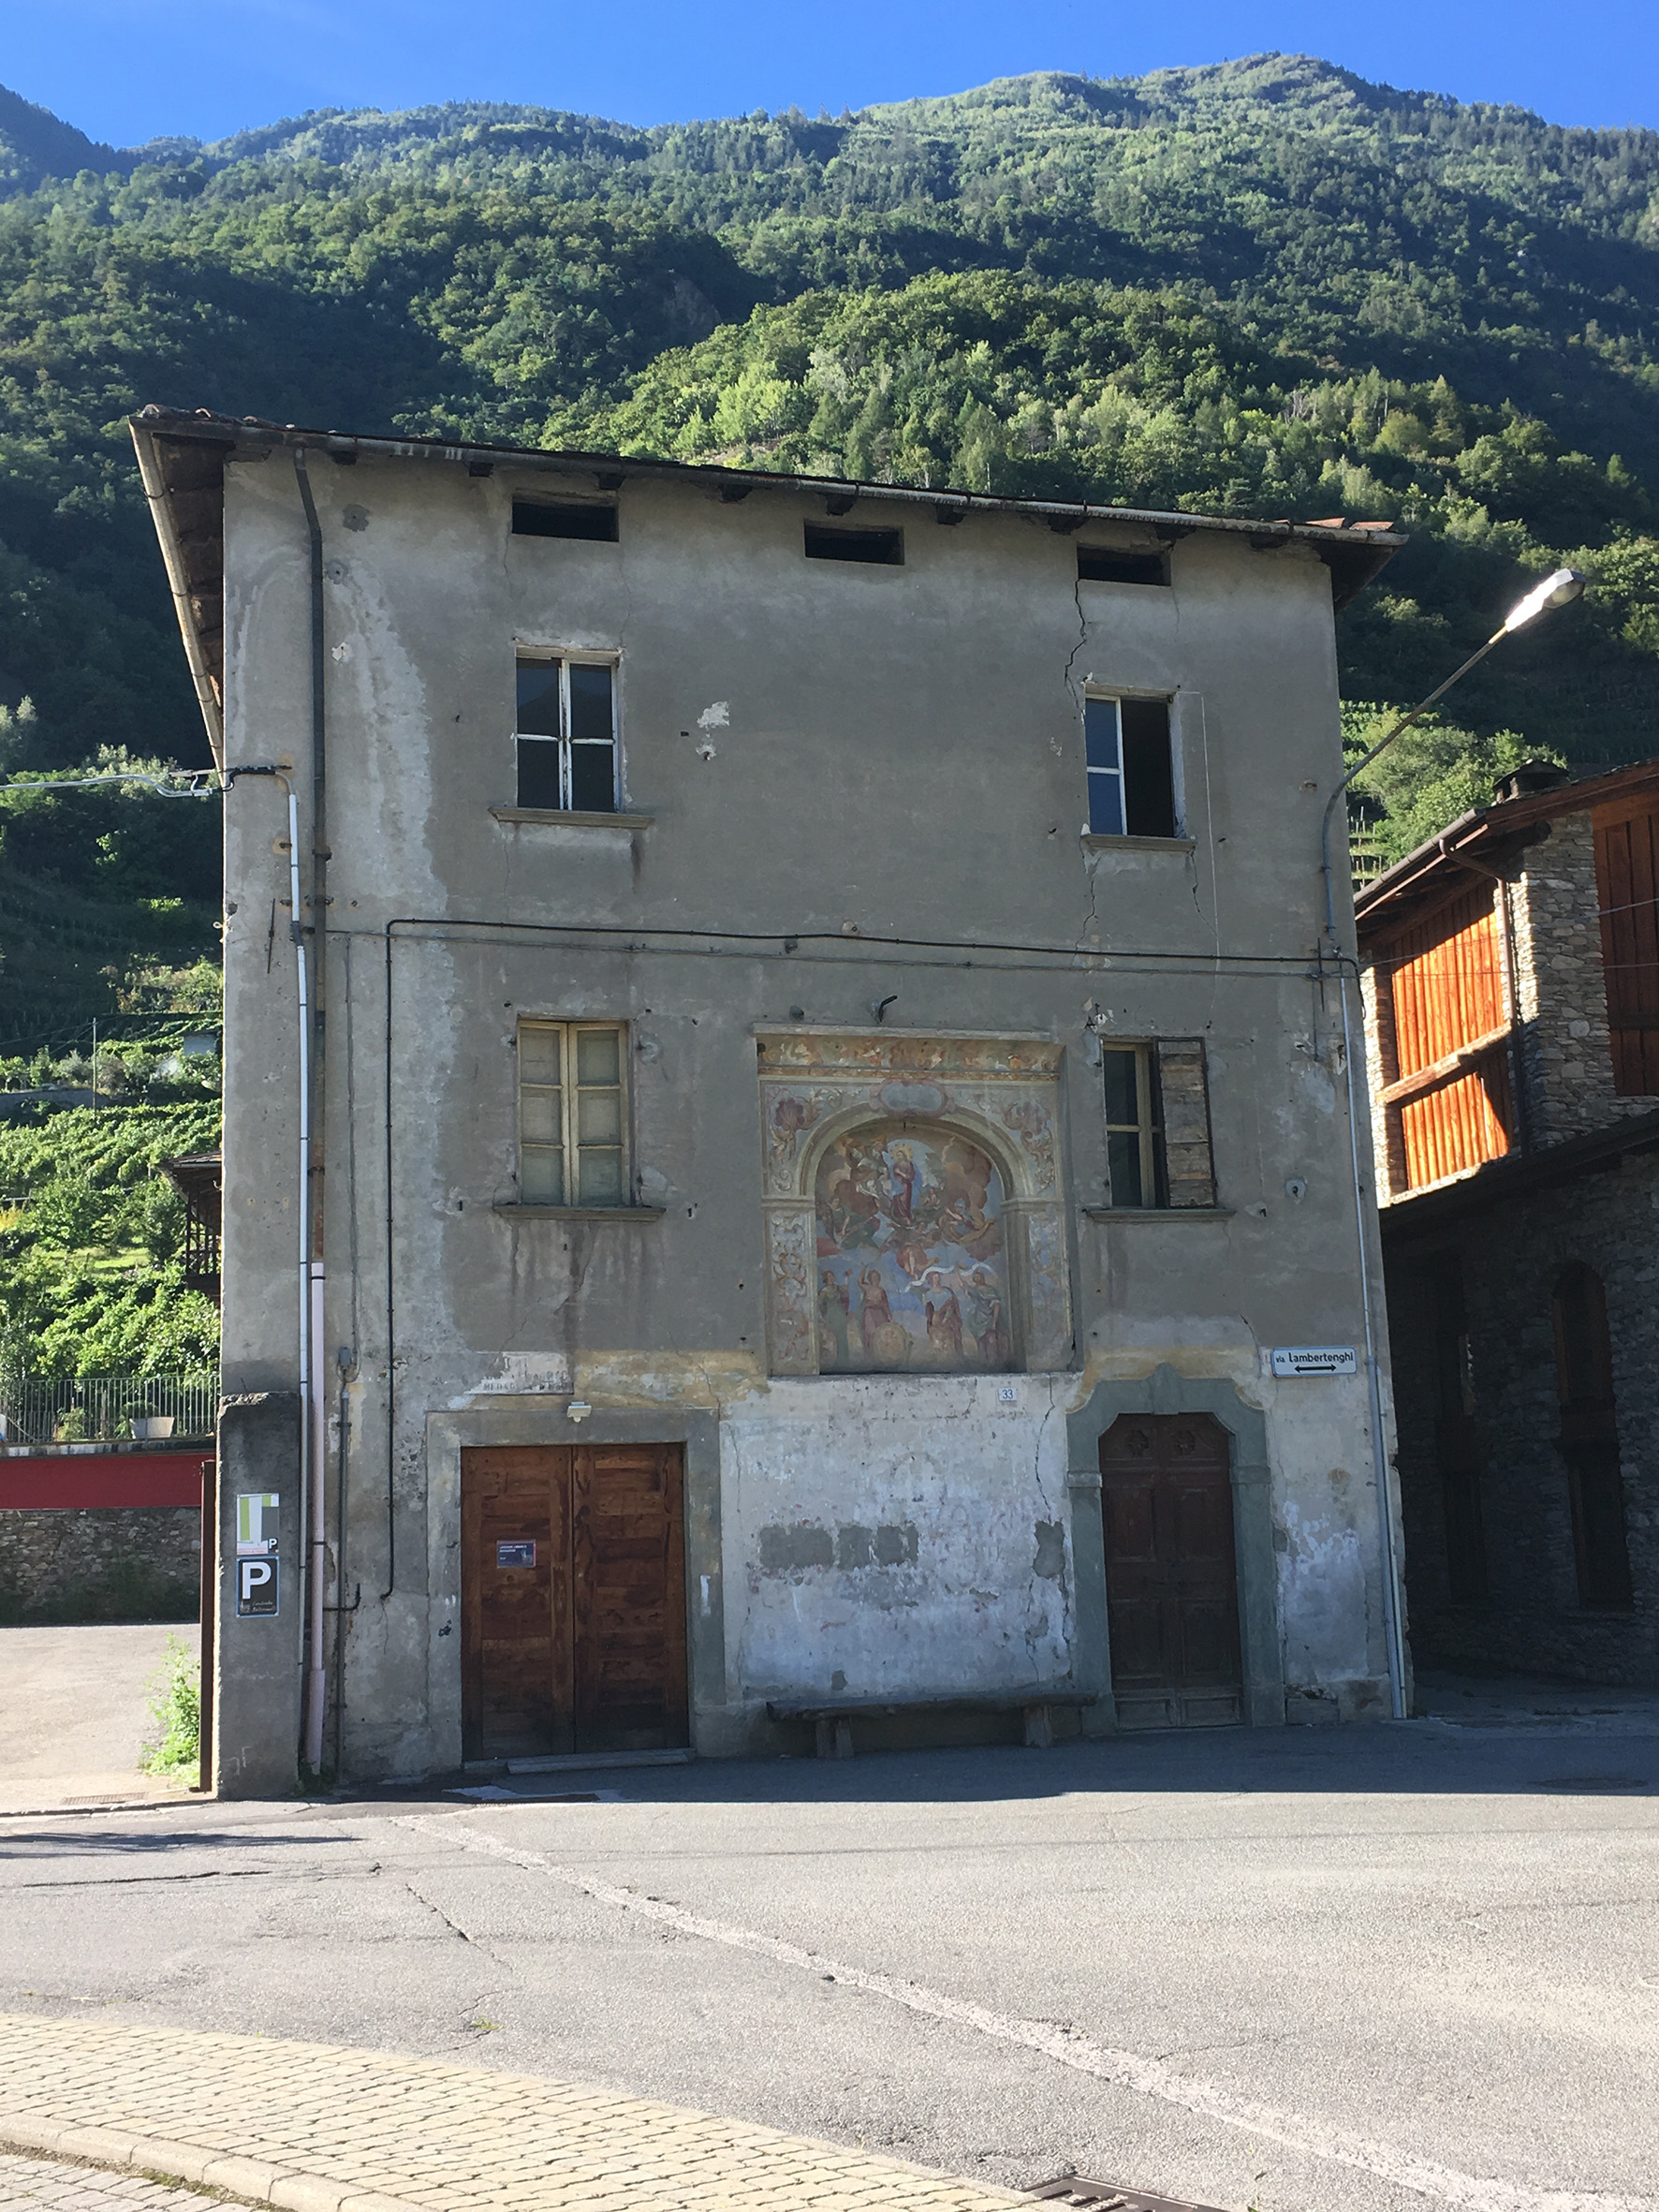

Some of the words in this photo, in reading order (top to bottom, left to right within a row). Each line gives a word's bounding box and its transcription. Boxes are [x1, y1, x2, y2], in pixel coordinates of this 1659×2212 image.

[1275, 1355, 1285, 1364] via
[1288, 1351, 1354, 1364] Lambertenghi
[1002, 1388, 1014, 1400] 33
[269, 1538, 278, 1550] P
[242, 1561, 272, 1600] P
